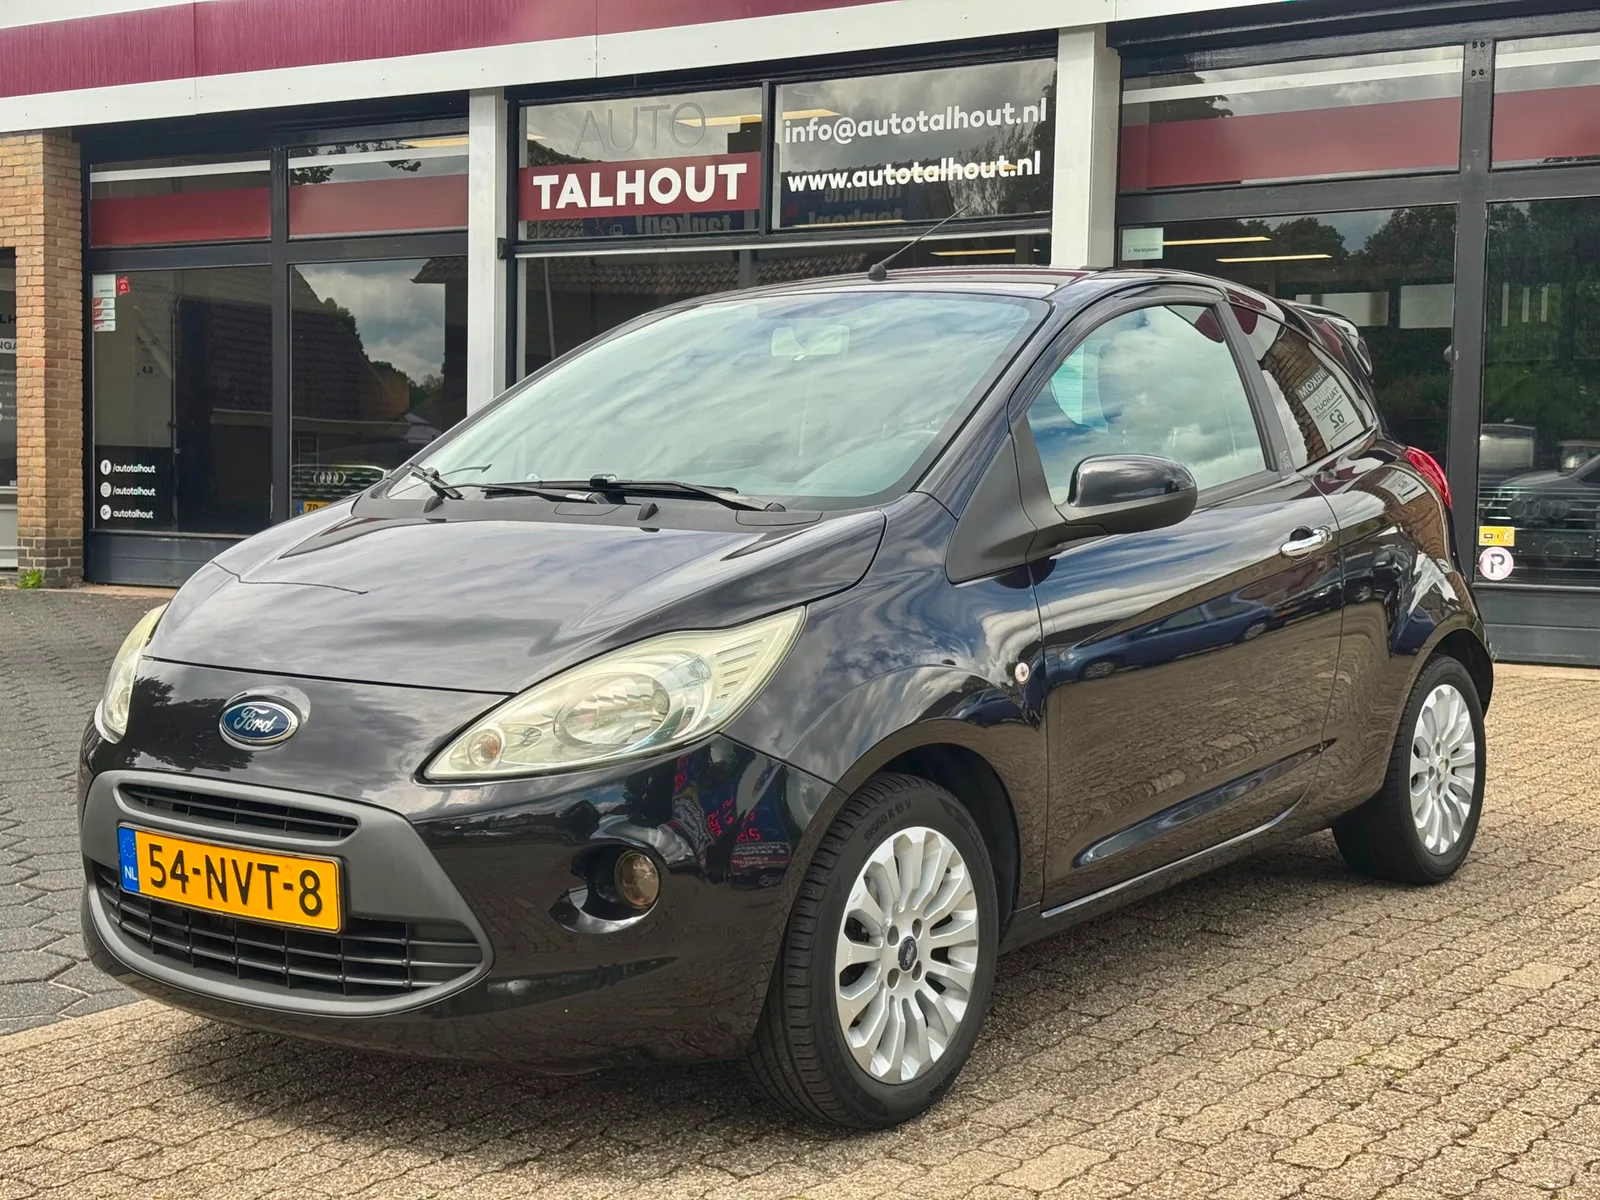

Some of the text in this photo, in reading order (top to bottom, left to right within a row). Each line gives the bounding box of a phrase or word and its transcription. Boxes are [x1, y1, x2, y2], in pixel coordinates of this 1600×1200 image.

[573, 102, 706, 153] AUTO
[785, 97, 1047, 144] info@autotalhout.nl
[532, 163, 748, 210] TALHOUT
[788, 150, 1041, 192] www.autotalhout.nl
[113, 463, 156, 473] /autotalhout
[113, 486, 156, 496] /autotalhout
[113, 509, 154, 519] autotalhout
[233, 706, 277, 733] Ford
[124, 865, 137, 880] NL
[148, 843, 323, 917] 54-NVT-8
